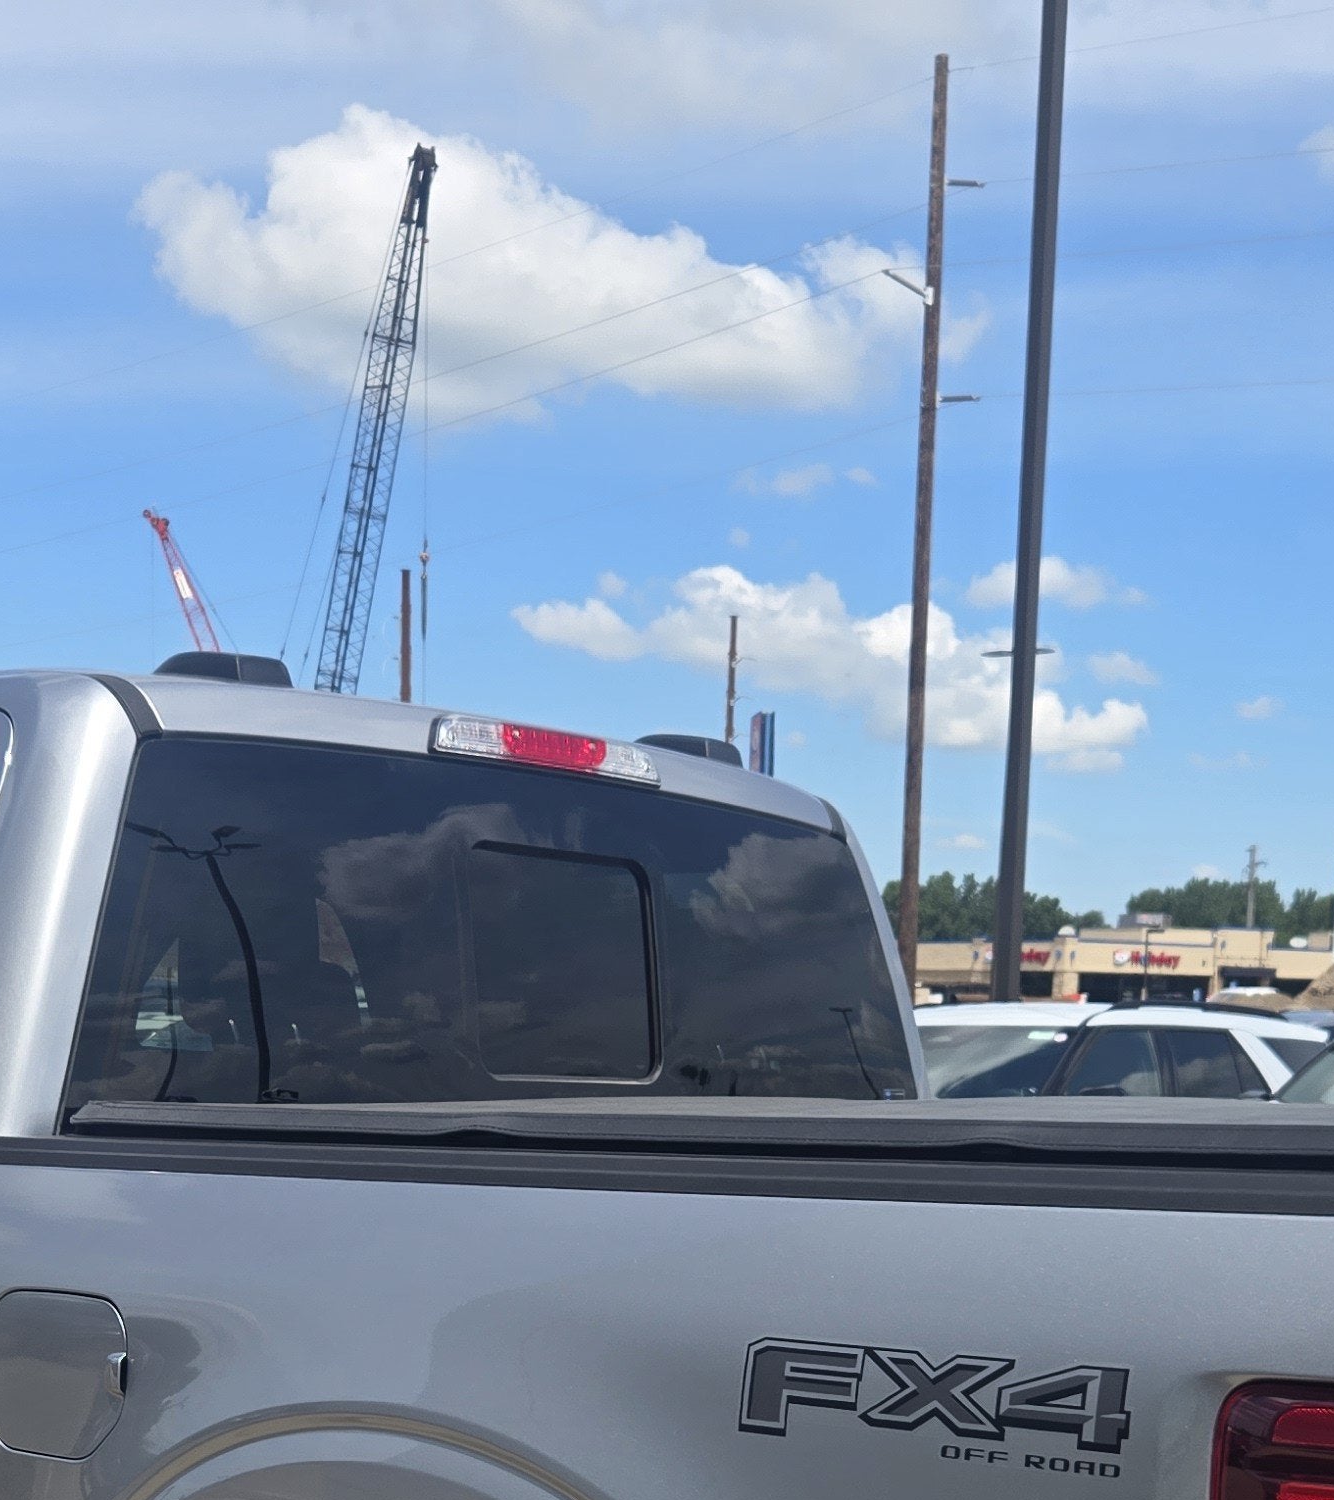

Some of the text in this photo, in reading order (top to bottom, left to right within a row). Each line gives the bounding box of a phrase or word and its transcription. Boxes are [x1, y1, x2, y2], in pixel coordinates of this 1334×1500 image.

[738, 1336, 1131, 1454] FX4
[940, 1444, 1121, 1479] OFF ROAD
